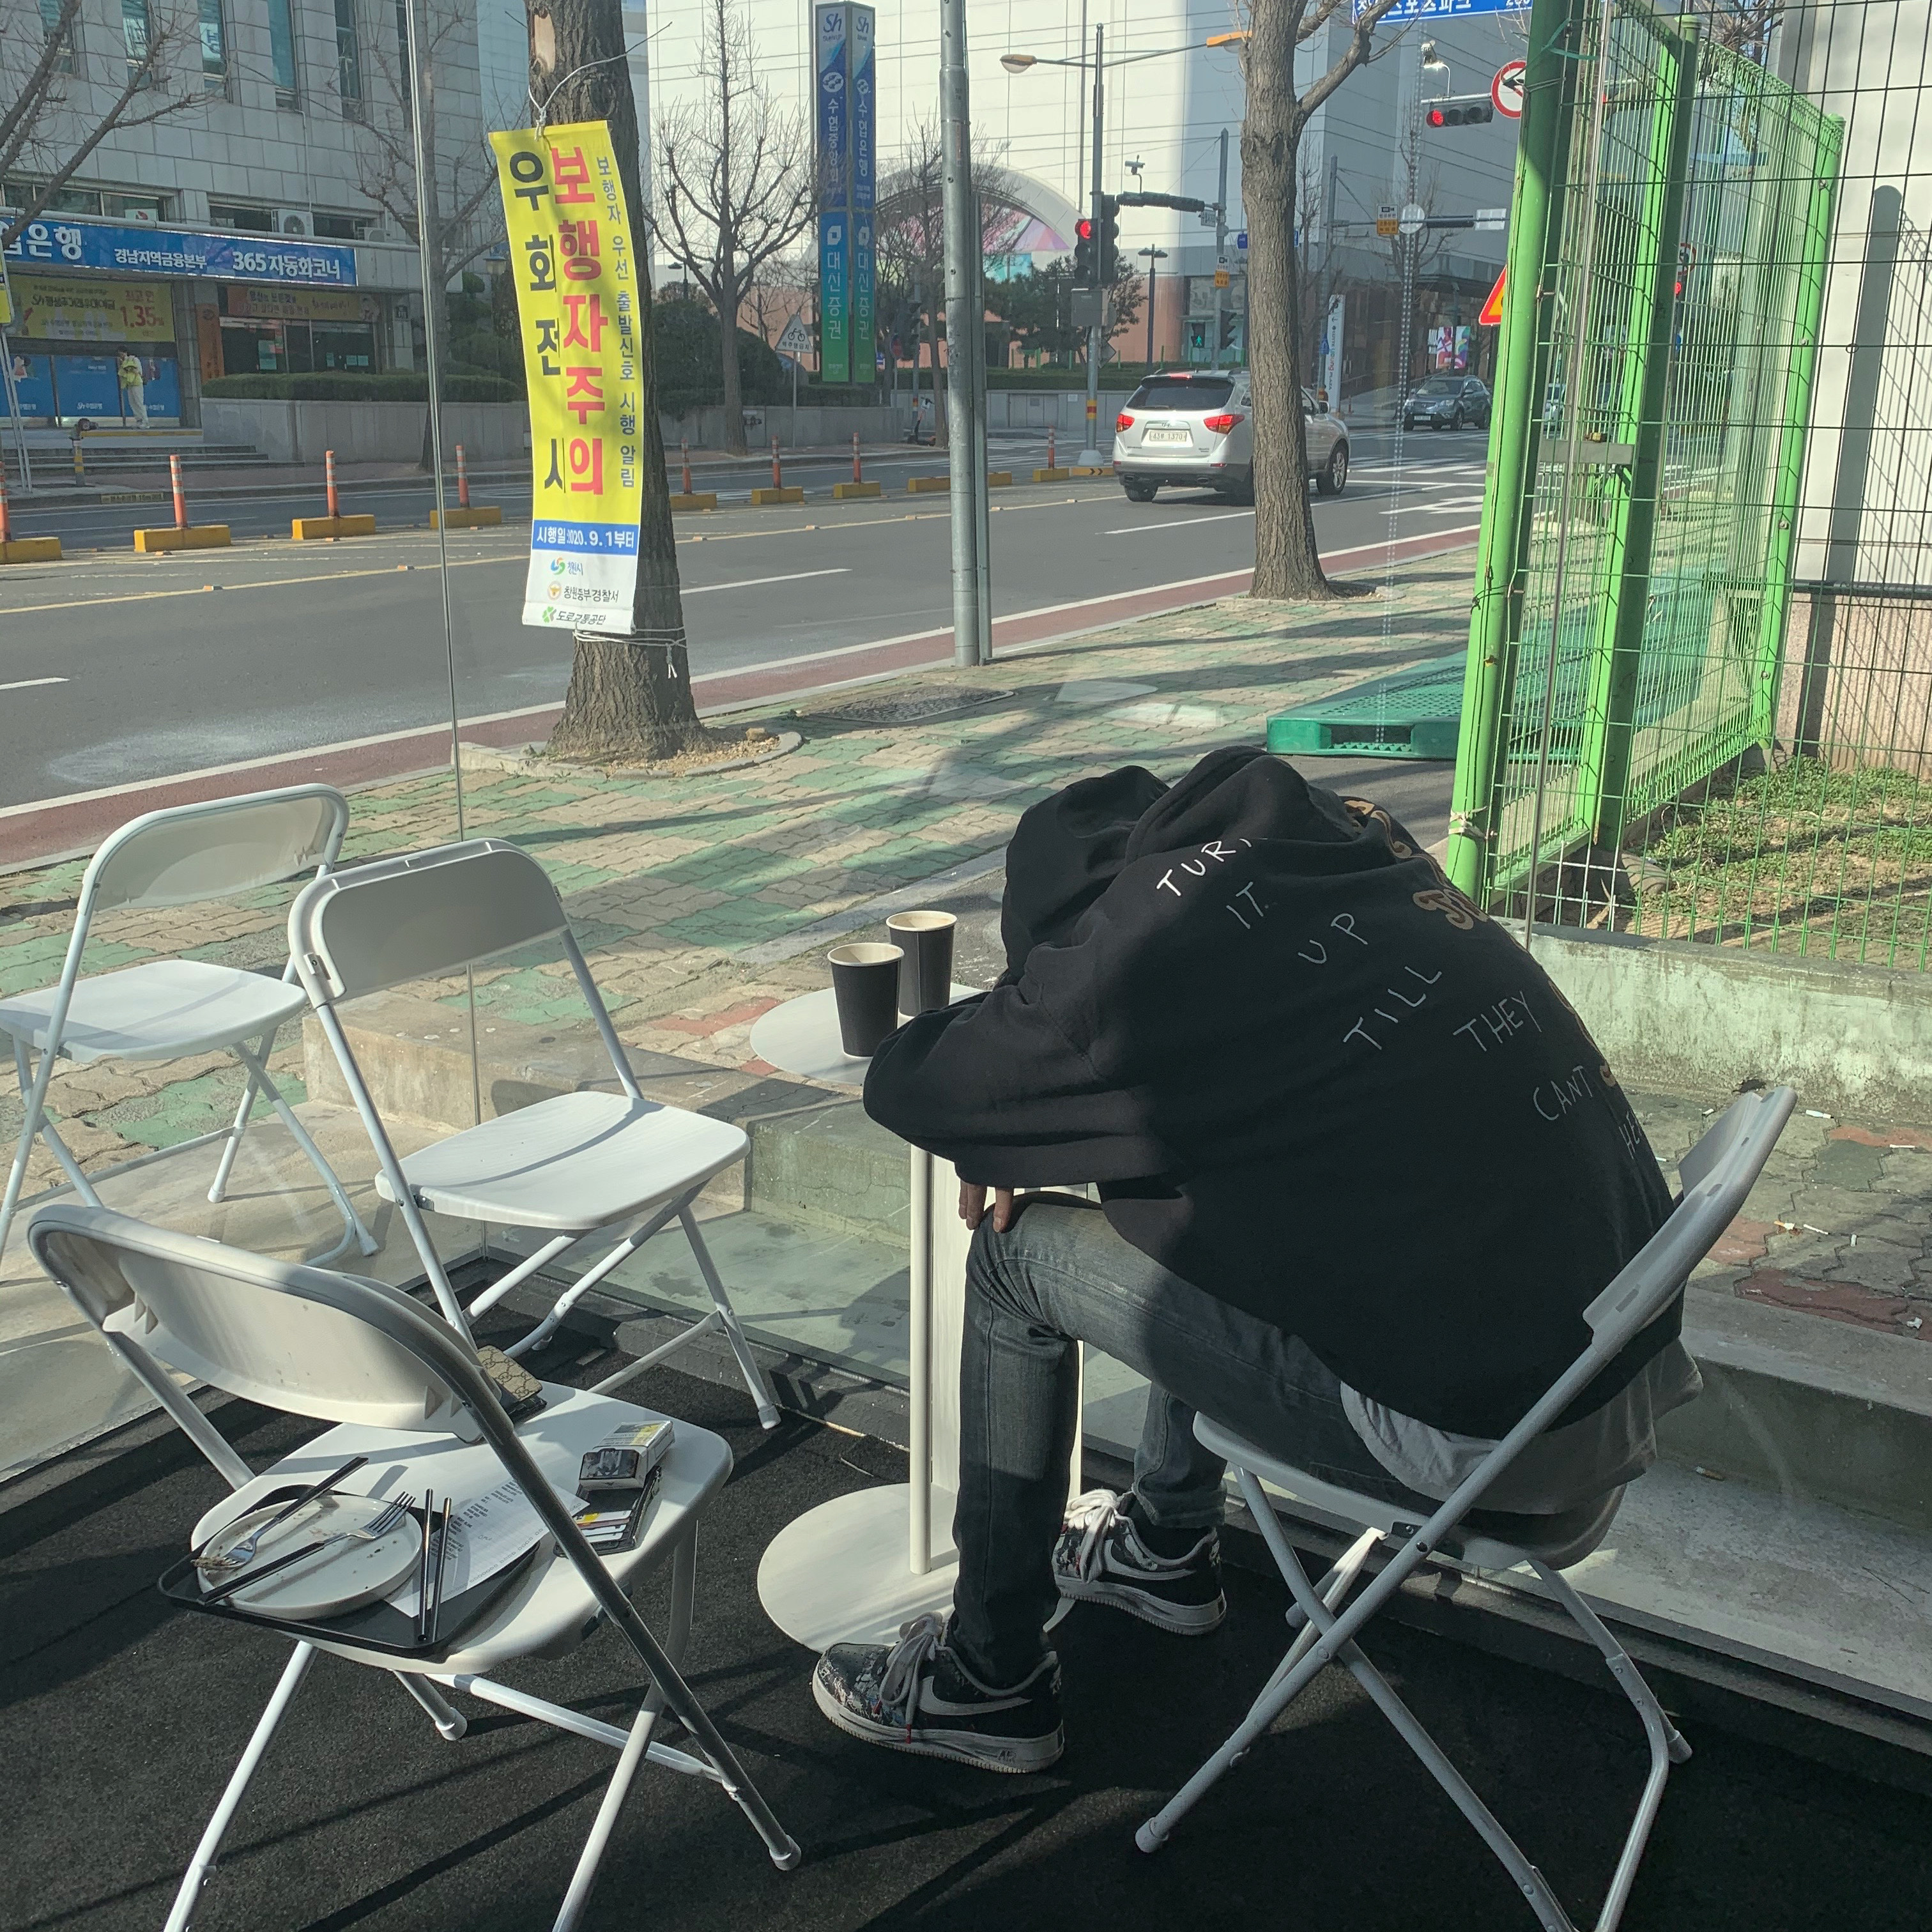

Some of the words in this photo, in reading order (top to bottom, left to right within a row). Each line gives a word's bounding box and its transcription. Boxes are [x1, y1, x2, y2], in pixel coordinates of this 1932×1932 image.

[823, 13, 842, 33] Sh
[856, 16, 869, 34] Sh
[858, 100, 868, 177] 수협은행
[596, 156, 622, 225] 보행자
[232, 251, 266, 272] 365
[268, 255, 341, 280] 자동화코너
[612, 235, 629, 280] 우선
[551, 146, 609, 496] 보행자주의
[827, 251, 841, 340] 대신증권
[858, 252, 870, 340] 대신증권
[616, 290, 635, 381] 출발신호
[620, 392, 636, 436] 시행
[620, 445, 636, 488] 알림
[564, 586, 619, 603] 창원중부경찰서
[567, 561, 583, 576] 창원시
[1225, 881, 1264, 930] IT
[1297, 912, 1369, 965] UP
[1342, 966, 1443, 1050] TILL
[1452, 990, 1543, 1052] THEY
[1532, 1065, 1593, 1121] CANT
